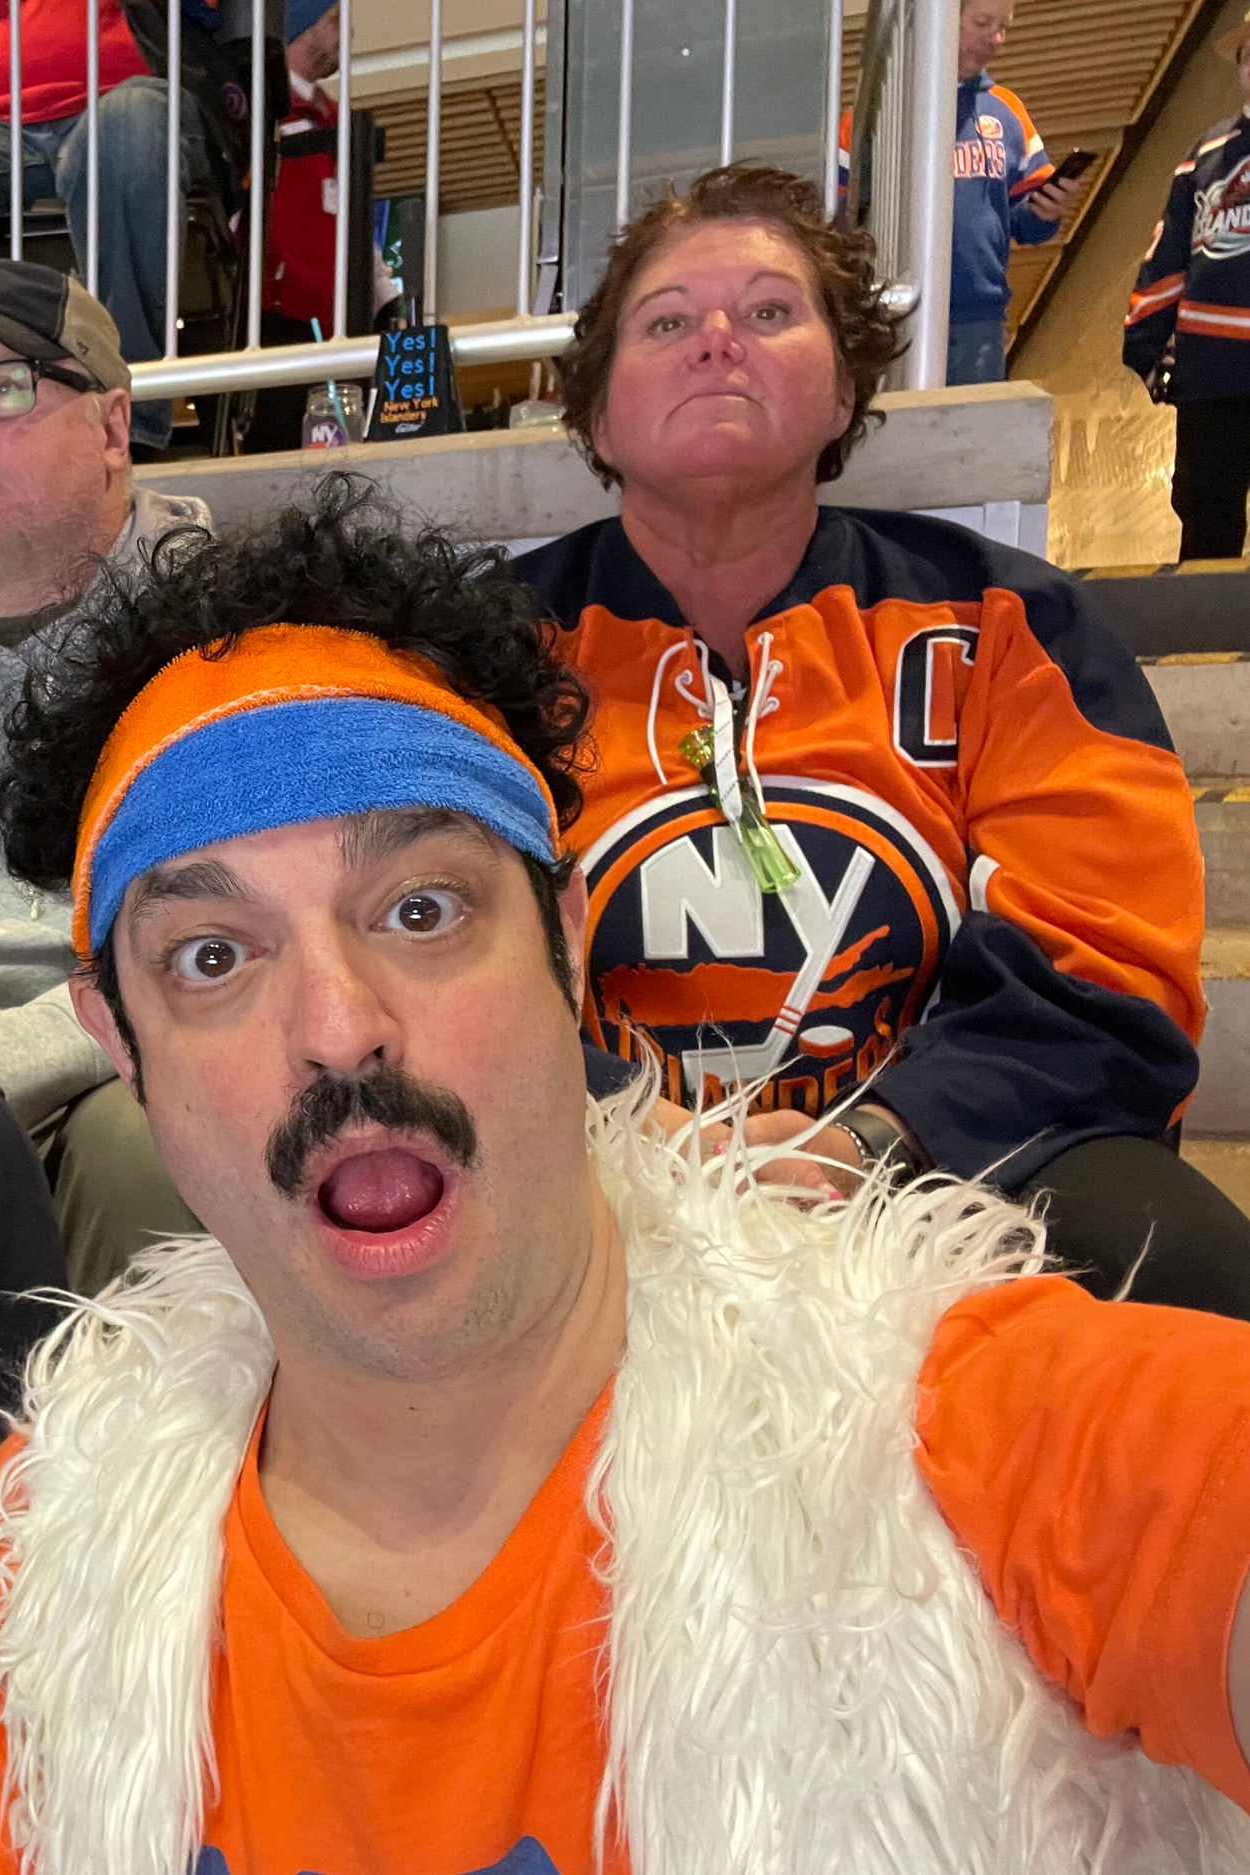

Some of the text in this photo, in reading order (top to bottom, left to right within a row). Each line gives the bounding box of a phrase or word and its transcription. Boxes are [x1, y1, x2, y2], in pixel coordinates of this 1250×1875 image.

[385, 327, 436, 353] Yes!
[384, 352, 435, 377] Yes!
[384, 375, 435, 401] Yes!
[412, 396, 439, 410] York
[893, 625, 980, 768] C
[640, 824, 875, 1020] NY
